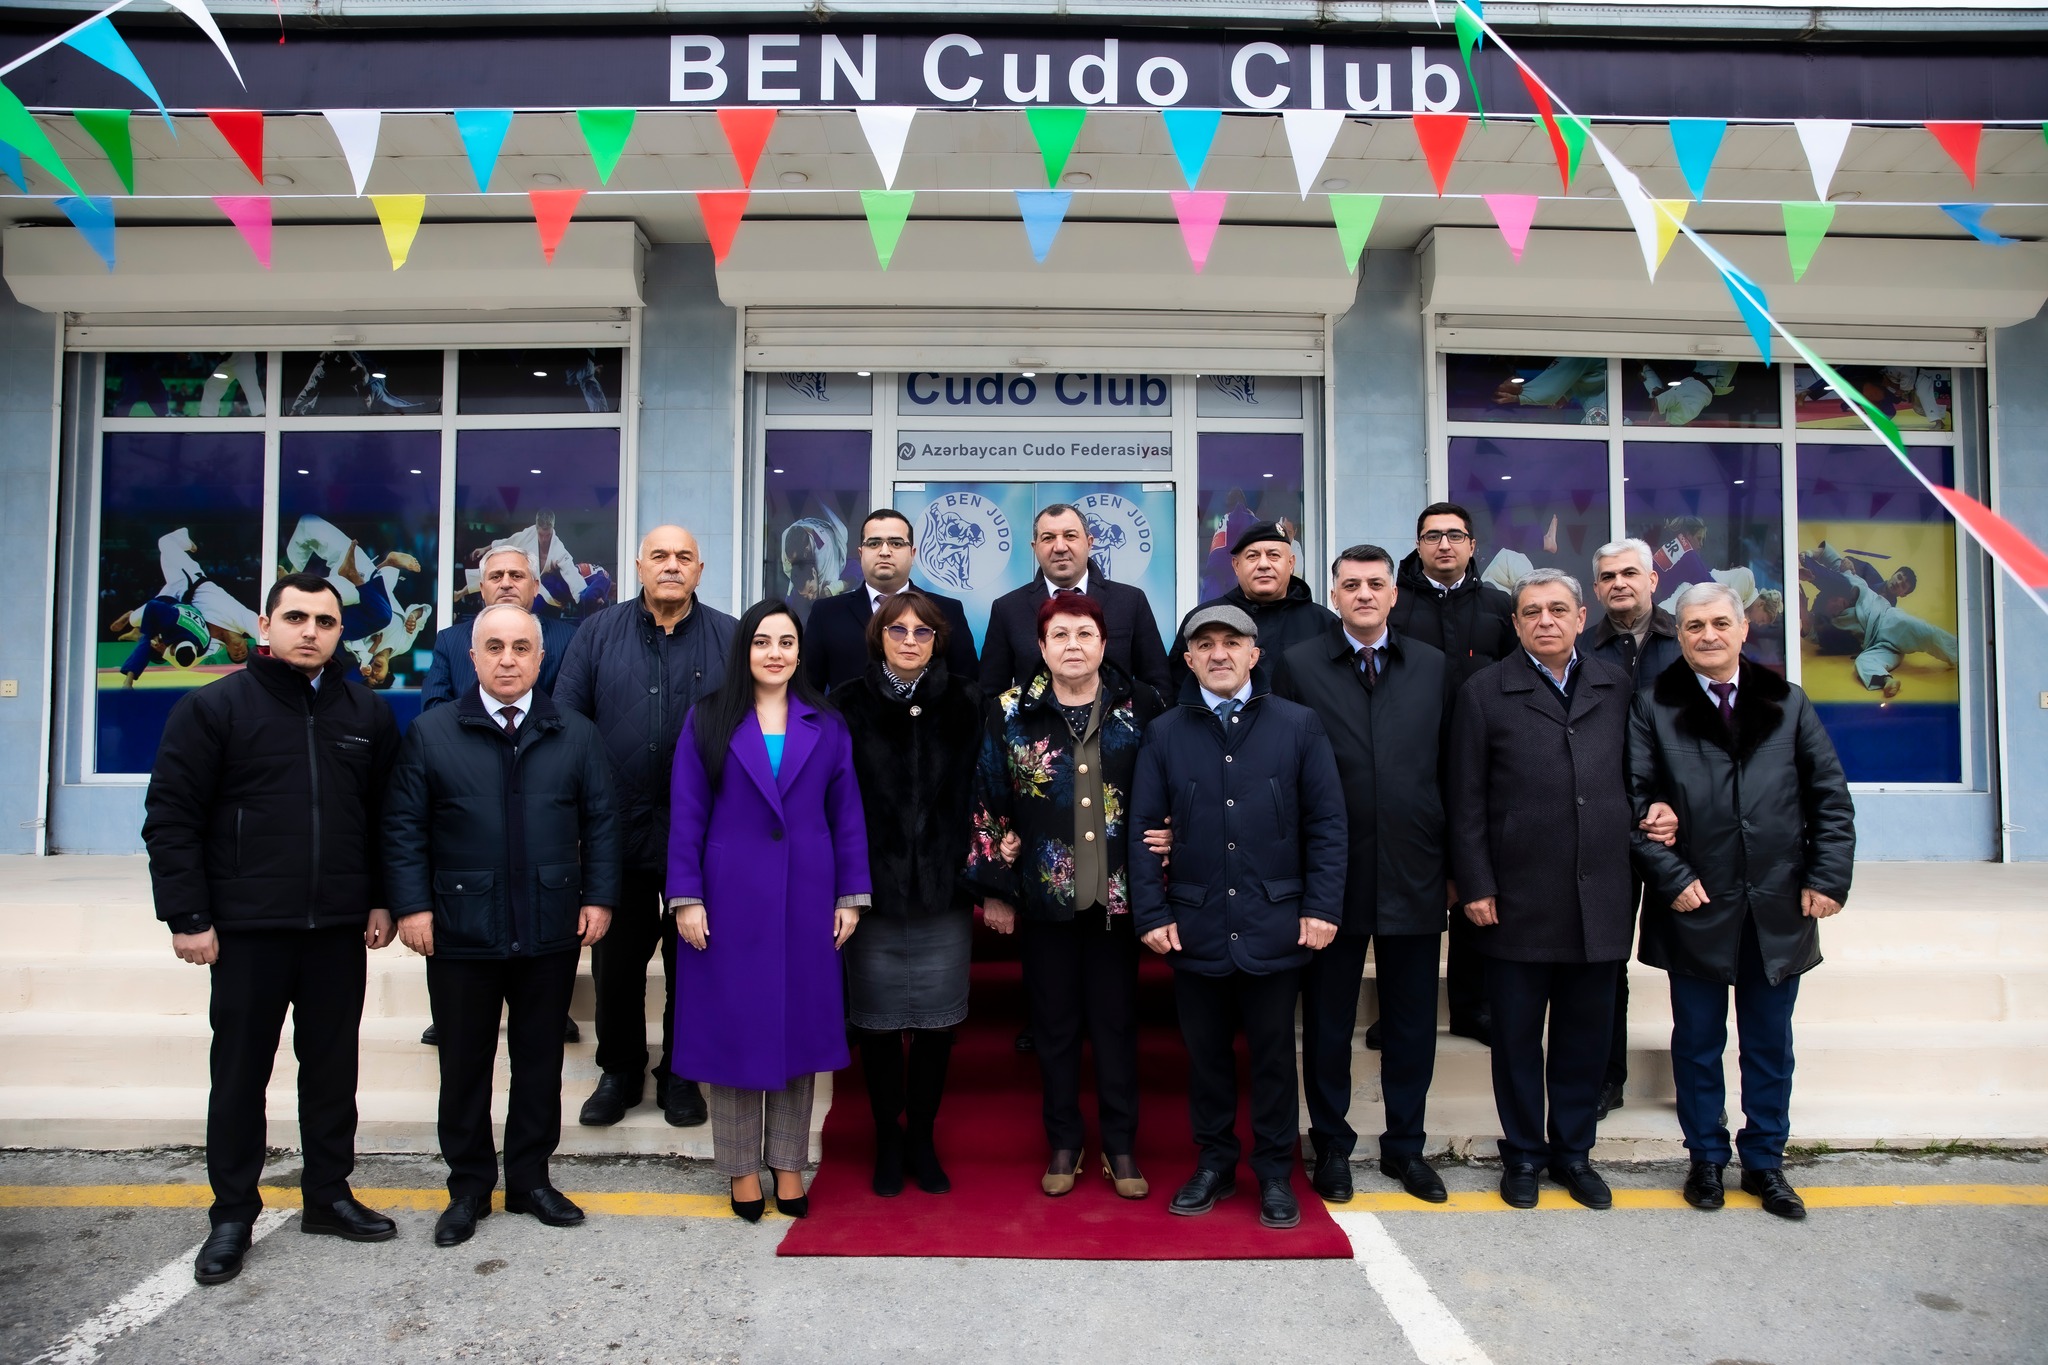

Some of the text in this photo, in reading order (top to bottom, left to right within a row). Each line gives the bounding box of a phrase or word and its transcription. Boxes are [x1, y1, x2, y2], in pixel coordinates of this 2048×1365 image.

[669, 34, 877, 102] BEN
[1231, 42, 1460, 112] Club
[906, 372, 1168, 407] Cudo Club
[921, 443, 1017, 459] Azərbaycan
[1022, 443, 1066, 456] Cudo
[945, 493, 1010, 552] BEN JUDO
[1086, 494, 1151, 553] BEN JUDO
